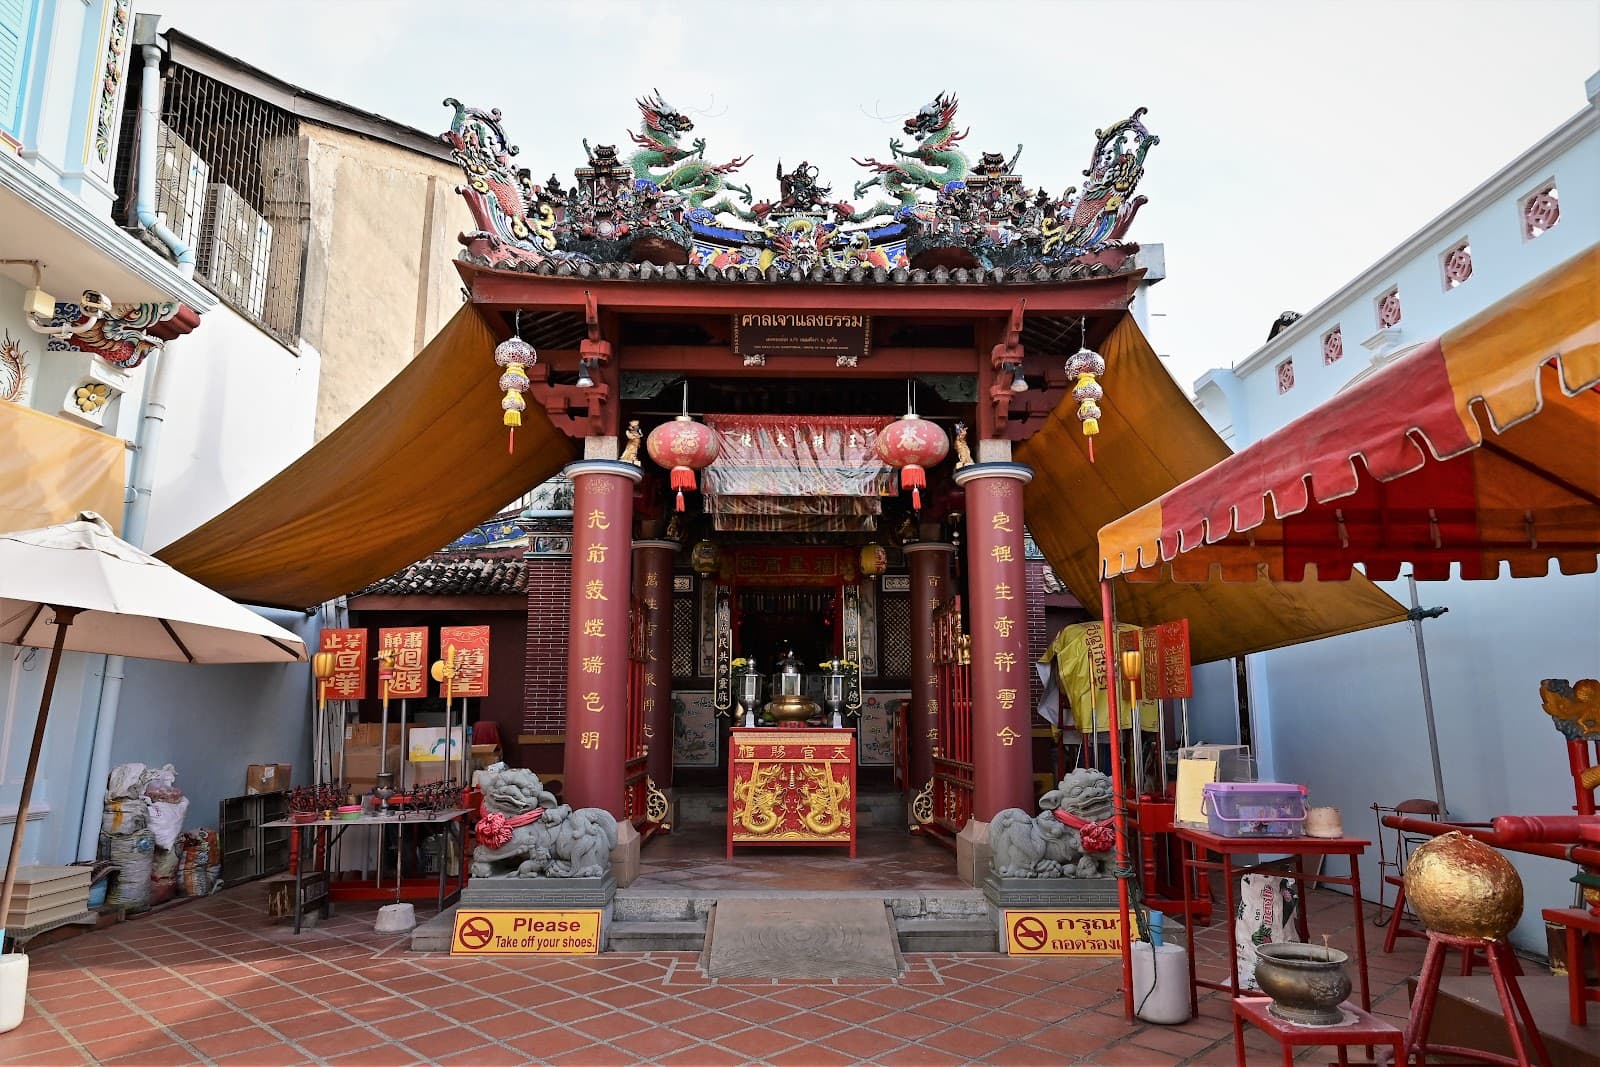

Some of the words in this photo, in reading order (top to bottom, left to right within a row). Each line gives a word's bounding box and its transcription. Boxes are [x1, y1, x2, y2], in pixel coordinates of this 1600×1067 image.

[513, 917, 581, 932] Please
[495, 935, 518, 948] Take
[521, 935, 535, 948] off
[537, 938, 561, 950] your
[562, 935, 596, 948] shoes.
